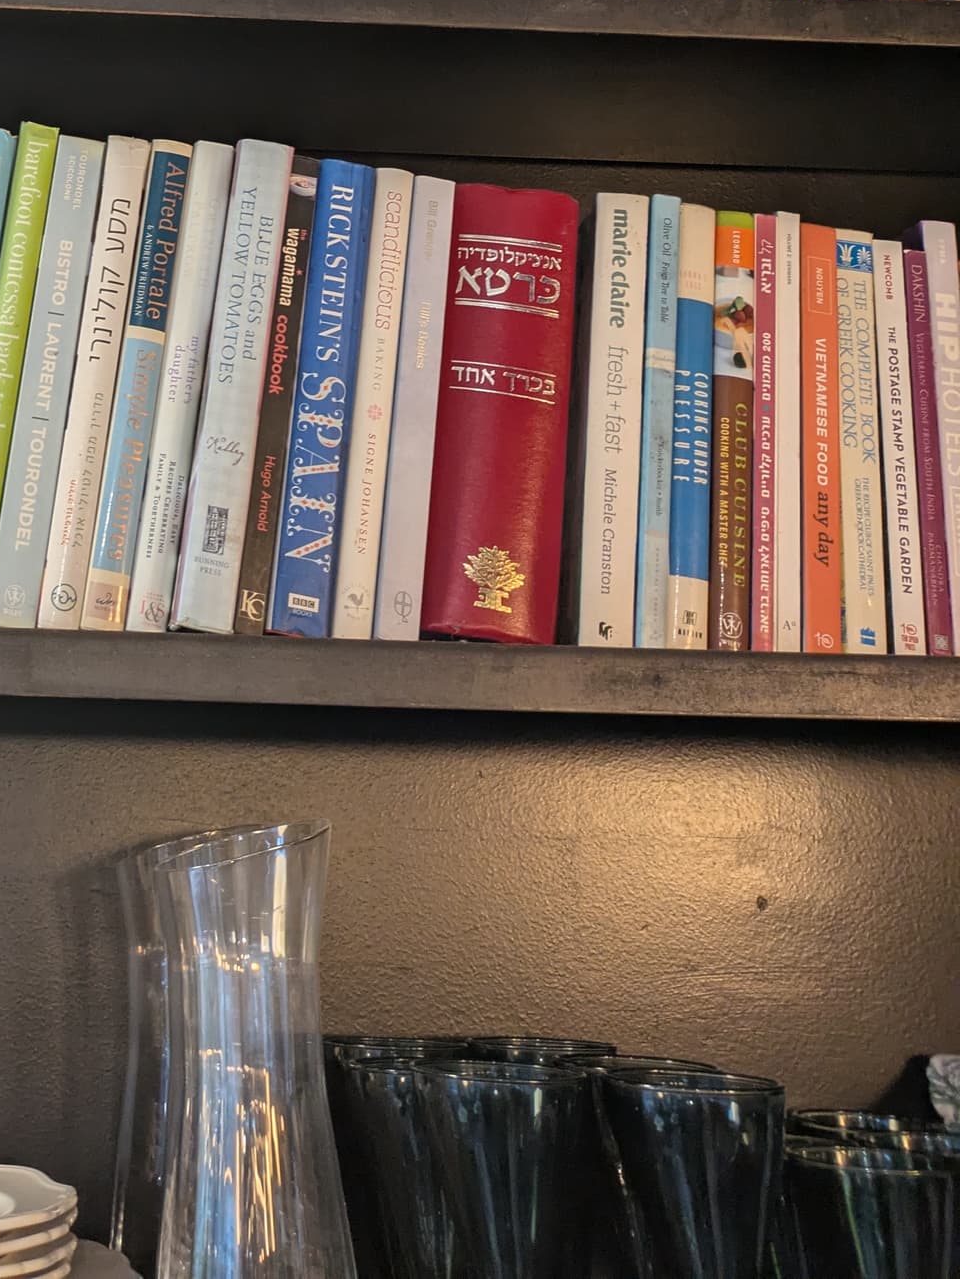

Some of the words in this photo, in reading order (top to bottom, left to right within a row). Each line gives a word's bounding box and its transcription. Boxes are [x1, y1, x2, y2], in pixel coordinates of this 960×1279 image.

[105, 198, 131, 254] מסע
[158, 162, 184, 232] Alfred
[326, 185, 354, 254] RICK
[233, 187, 257, 266] YELLOW
[254, 216, 274, 266] BLUE
[612, 208, 634, 267] marie
[50, 240, 73, 306] BISTRO
[146, 235, 177, 321] Portale
[278, 228, 299, 307] wagamama
[883, 255, 894, 300] NEWCOMB
[89, 266, 125, 363] קולינרי
[219, 271, 246, 384] TOMATOES
[247, 273, 266, 325] EGGS
[315, 254, 348, 364] STEIN'S
[609, 270, 633, 328] claire
[242, 329, 256, 361] and
[268, 314, 288, 394] cookbook
[762, 332, 771, 352] 200
[888, 327, 896, 344] THE
[37, 322, 62, 411] LAURENT
[451, 365, 495, 386] אחד
[503, 370, 556, 395] בכרך
[605, 344, 630, 396] fresh
[762, 356, 771, 401] מתכונים
[815, 339, 828, 438] VIETNAMESE
[890, 347, 902, 405] POSTAGE
[673, 370, 690, 482] PRESSURE
[694, 372, 708, 433] COOKING
[891, 410, 905, 452] STAMP
[364, 433, 376, 474] SIGNE
[604, 412, 627, 454] fast
[15, 427, 47, 552] TOURONDEL
[261, 455, 276, 488] Hugo
[285, 372, 346, 572] SPAIN
[693, 440, 708, 485] UNDER
[816, 442, 829, 486] FOOD
[257, 493, 272, 532] Arnold
[358, 481, 372, 555] JOHANSEN
[601, 469, 618, 526] Michele
[813, 491, 829, 528] any
[894, 457, 909, 532] VEGETABLE
[600, 530, 616, 595] Cranston
[815, 532, 834, 567] day
[899, 536, 913, 594] GARDEN
